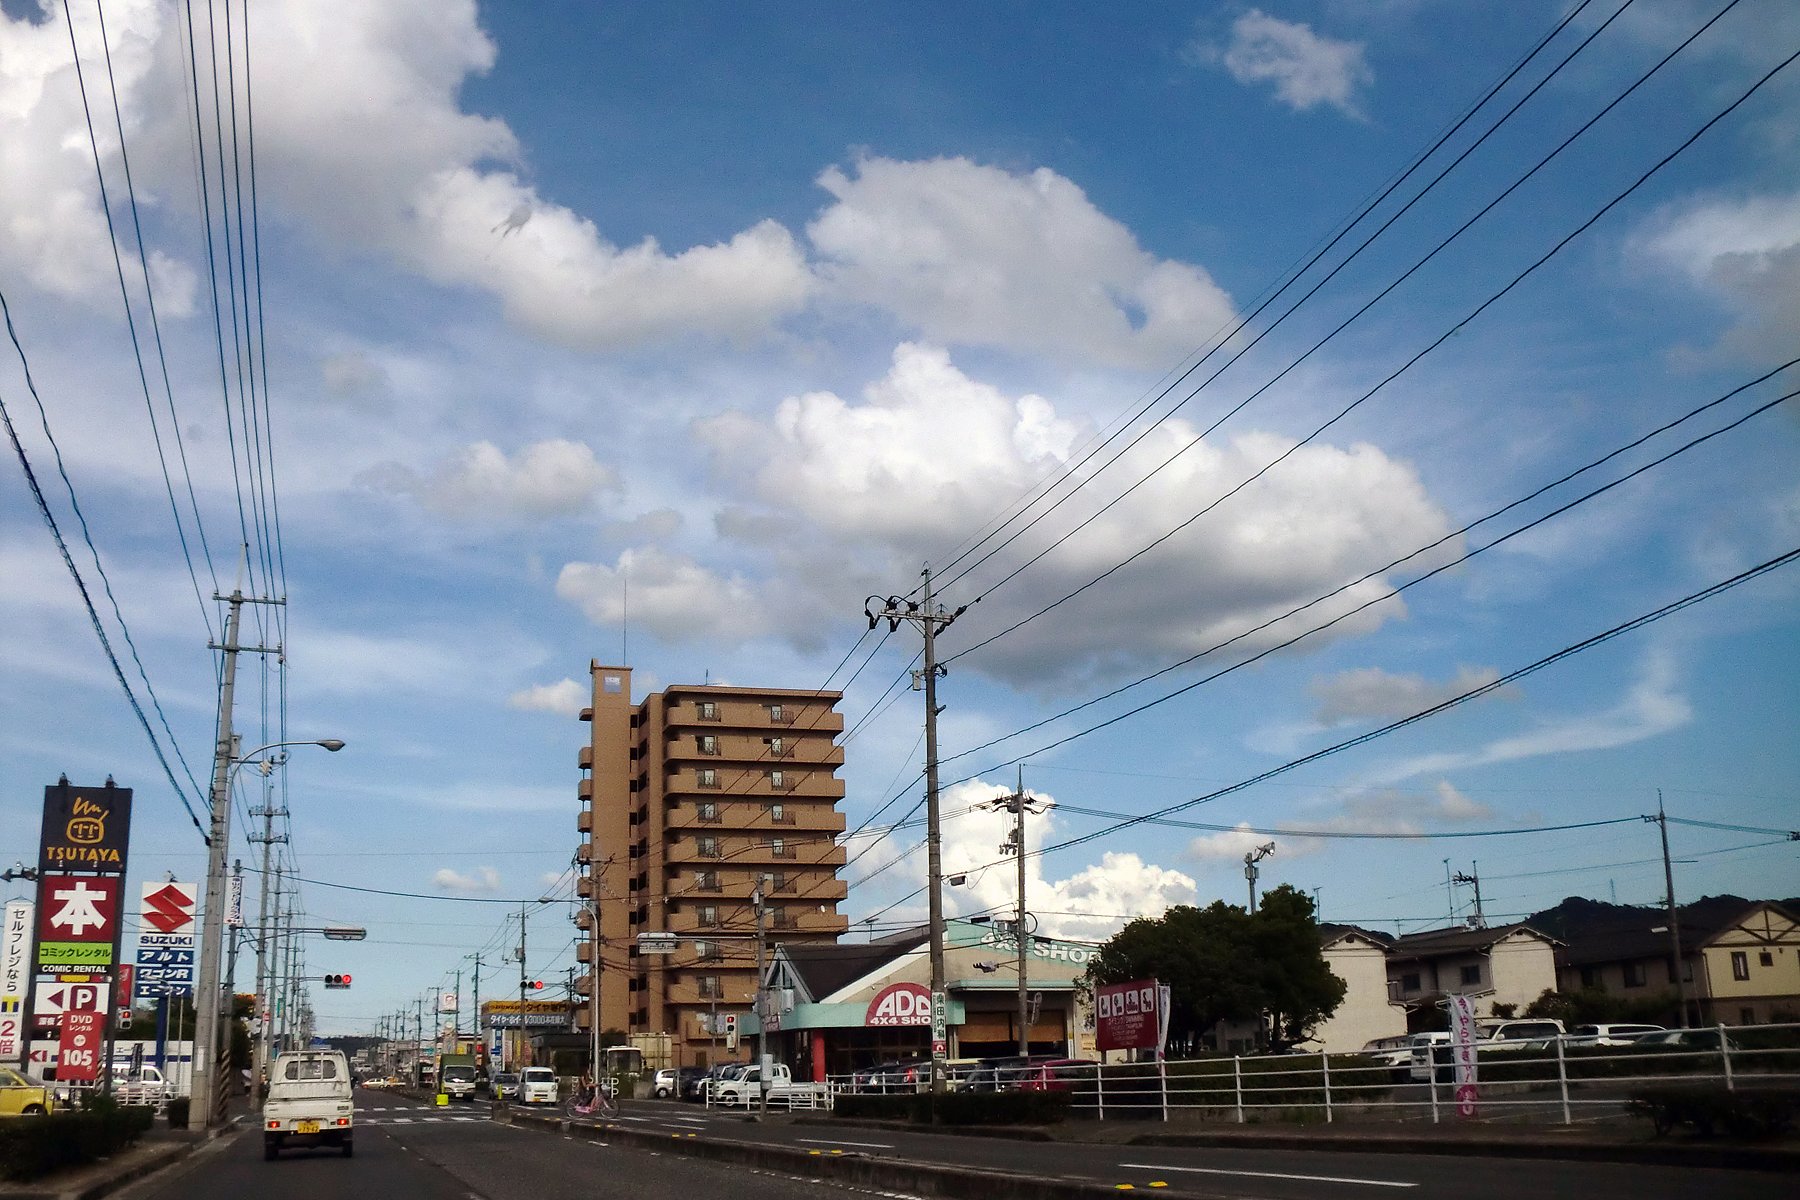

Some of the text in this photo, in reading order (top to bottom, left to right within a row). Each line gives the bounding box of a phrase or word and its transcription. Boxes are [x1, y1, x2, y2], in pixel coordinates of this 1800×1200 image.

[47, 846, 121, 862] TSUTAYA
[50, 881, 107, 935] 本
[140, 936, 192, 945] SUZUKI
[6, 909, 25, 992] セルフレジなら
[40, 946, 111, 958] コミックレンタル
[140, 951, 189, 962] アルト
[42, 964, 107, 974] COMIC RENTAL
[140, 968, 189, 979] ワゴンR
[76, 989, 93, 1009] P
[70, 1015, 93, 1024] DVD
[870, 1016, 898, 1025] 4X4
[63, 1049, 92, 1066] 105
